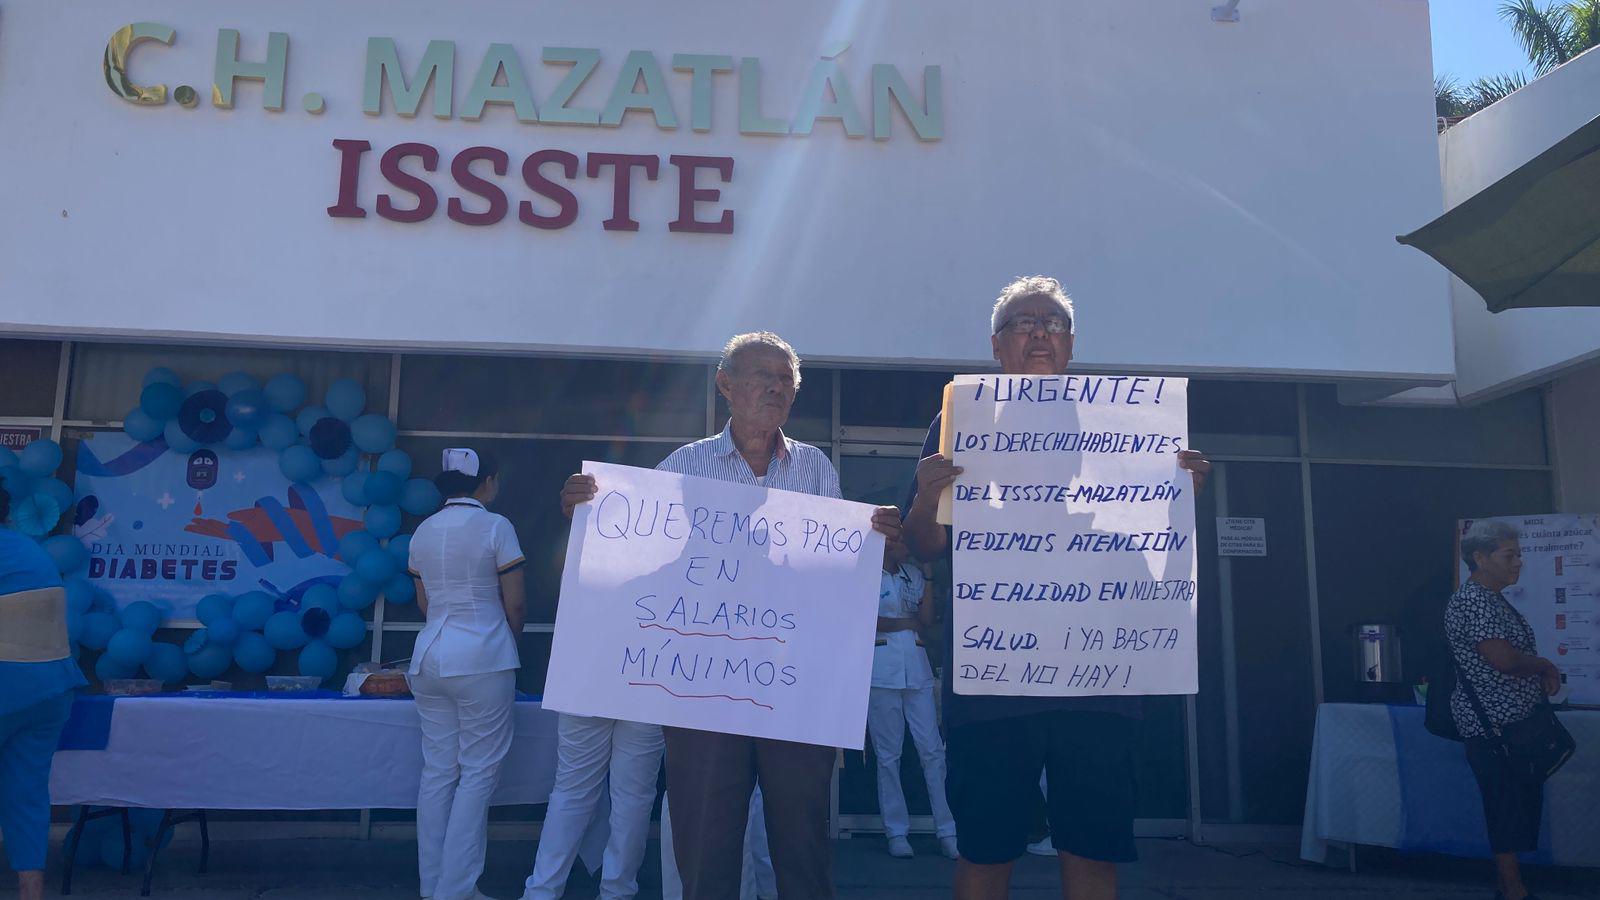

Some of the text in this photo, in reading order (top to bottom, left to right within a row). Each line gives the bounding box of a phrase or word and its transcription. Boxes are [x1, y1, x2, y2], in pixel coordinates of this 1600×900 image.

[362, 36, 944, 142] MAZATLÁN
[326, 138, 735, 235] ISSSTE
[954, 431, 1182, 454] LOS DERECHOHABIENTES
[596, 489, 863, 554] QUEREMOS PAGO
[134, 543, 225, 557] MUNDIAL
[955, 526, 1188, 552] PEDIMOS ATENCIÓN
[88, 557, 238, 581] DIABETES
[686, 556, 739, 586] EN
[956, 579, 1196, 602] DE CALIDAD EN NUESTRA
[635, 595, 797, 630] SALARIOS
[962, 625, 1040, 651] SALUD.
[1112, 627, 1179, 651] BASTA
[621, 638, 798, 687] MÍNIMOS
[960, 662, 1010, 683] DEL
[1020, 662, 1059, 685] NO
